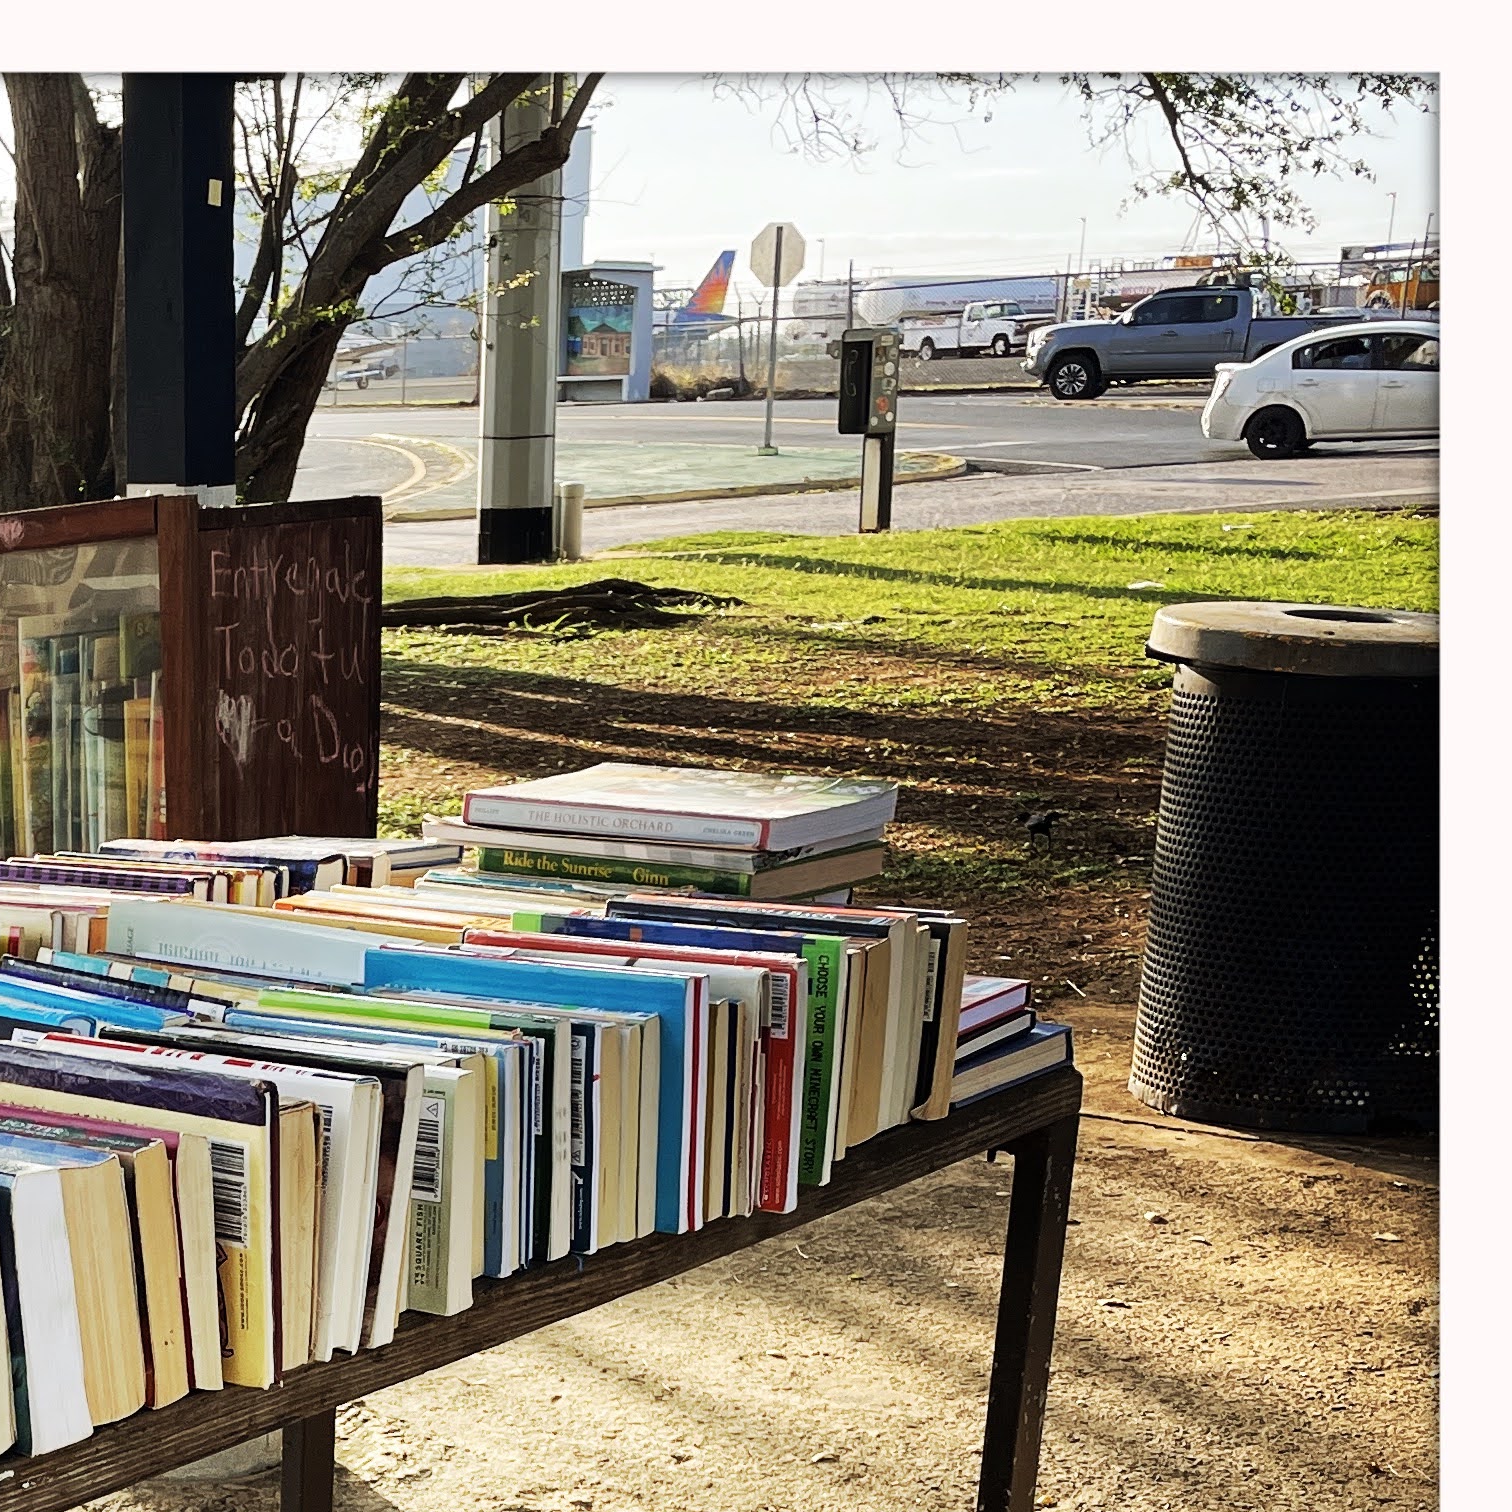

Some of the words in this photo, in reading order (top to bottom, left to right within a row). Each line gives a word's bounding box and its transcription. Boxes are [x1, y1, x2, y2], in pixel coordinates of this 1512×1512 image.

[528, 809, 551, 822] THE
[554, 812, 609, 828] HOLISTIC
[613, 816, 674, 833] ORCHARD
[502, 849, 534, 869] Ride
[536, 851, 559, 871] the
[561, 854, 614, 879] Sunrise
[631, 866, 670, 886] Ginn
[814, 954, 830, 999] CHOOSE
[812, 1004, 827, 1036] YOUR
[811, 1040, 824, 1063] OWN
[806, 1067, 823, 1132] MINECRAFT
[801, 1137, 817, 1175] STORY
[416, 1203, 425, 1228] FISH
[414, 1231, 424, 1275] SQUARE
